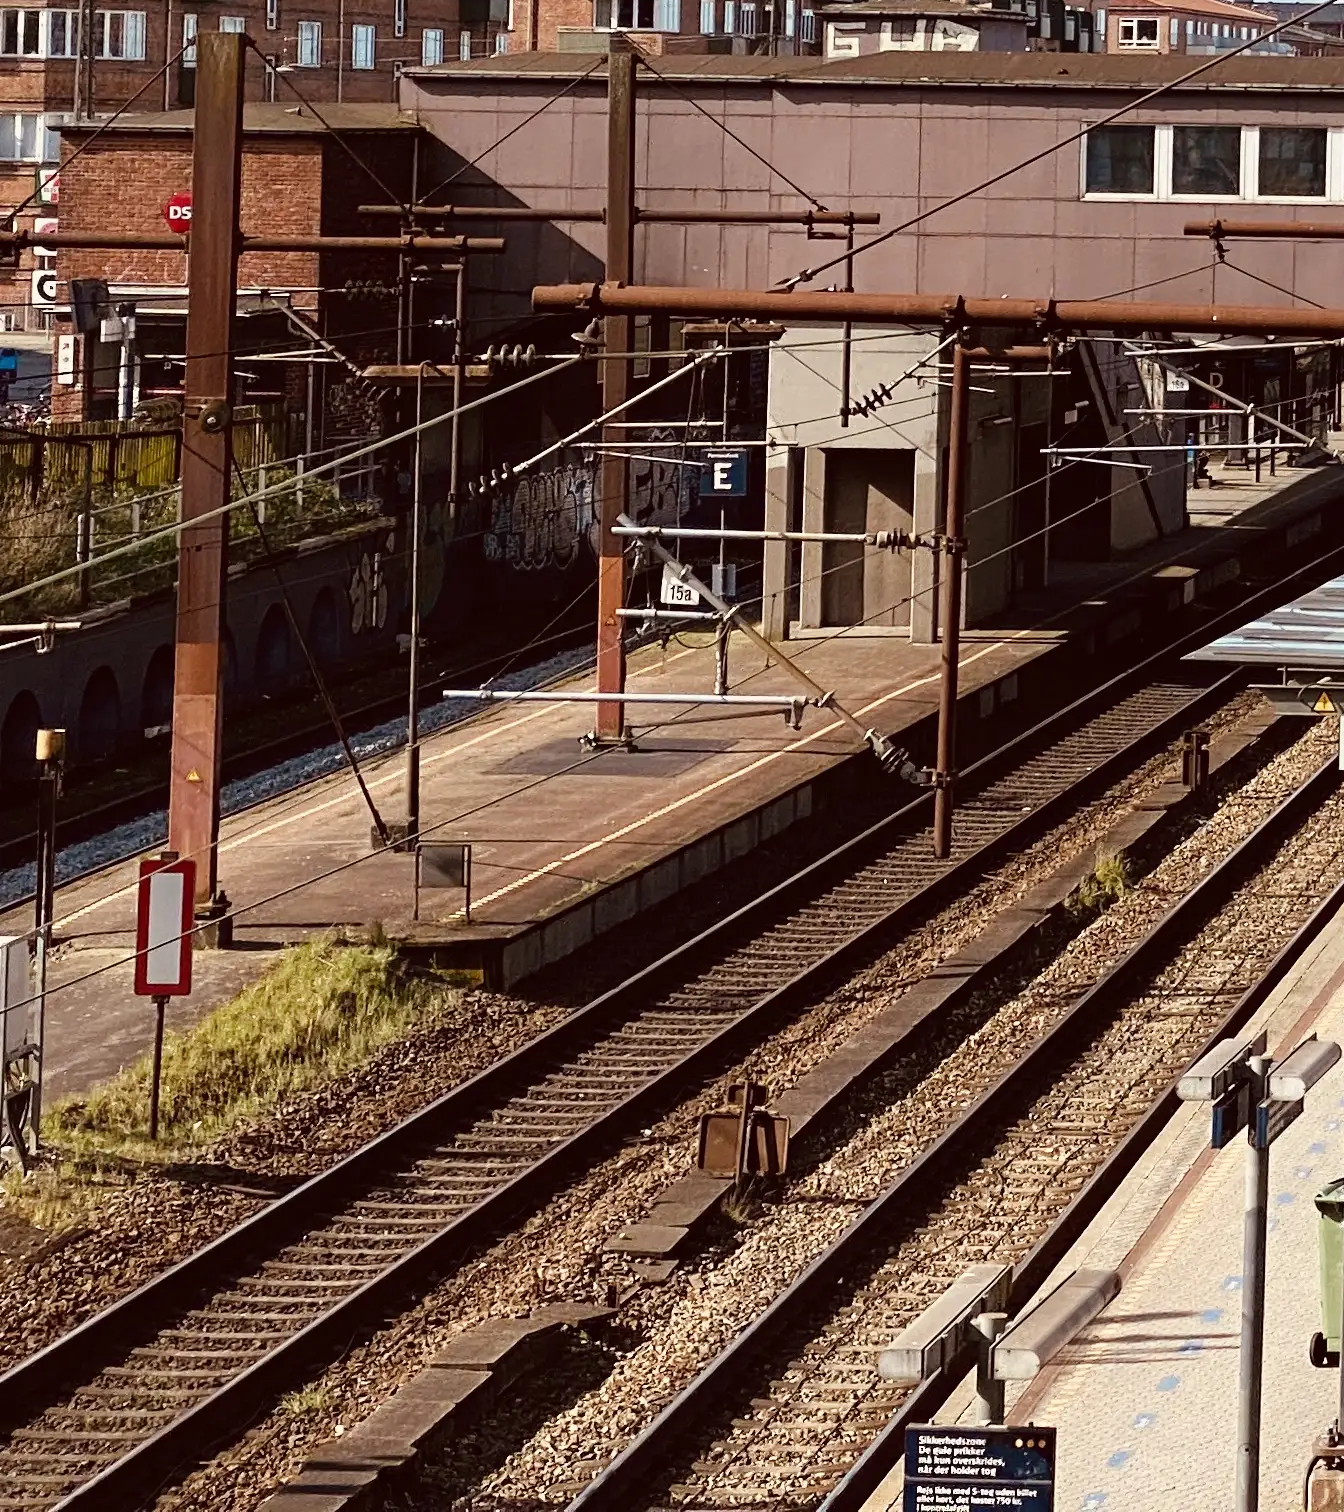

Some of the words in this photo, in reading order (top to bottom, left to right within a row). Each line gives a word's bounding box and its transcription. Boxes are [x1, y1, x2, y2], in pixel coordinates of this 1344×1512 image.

[169, 205, 192, 220] DS
[713, 462, 732, 489] E
[670, 585, 692, 601] 15a
[919, 1446, 931, 1455] De
[932, 1446, 952, 1456] gule
[953, 1447, 986, 1456] prikker
[918, 1455, 932, 1464] må
[934, 1456, 951, 1465] kun
[918, 1464, 933, 1474] når
[934, 1466, 950, 1474] der
[951, 1466, 980, 1475] holder
[981, 1467, 997, 1477] tog
